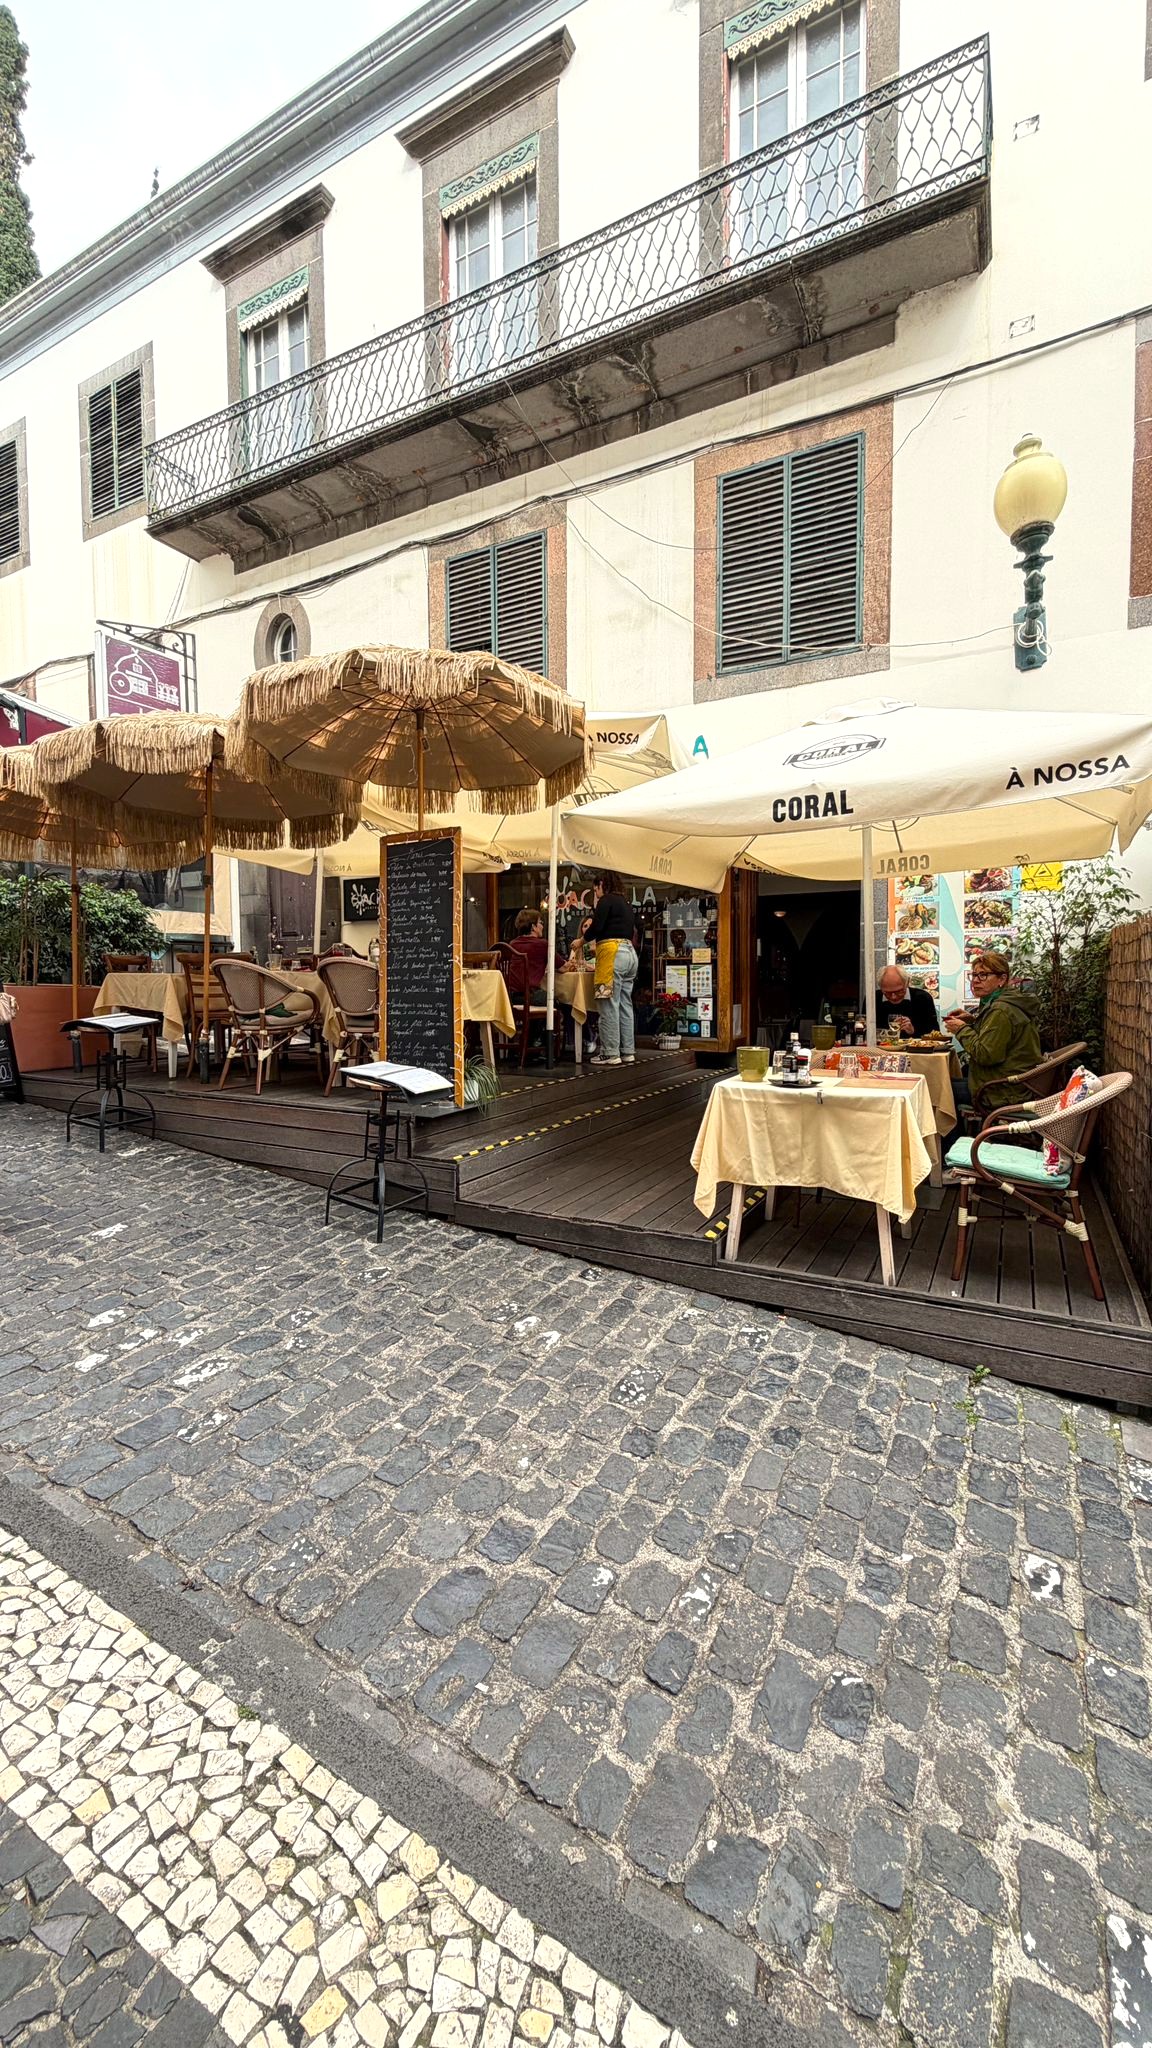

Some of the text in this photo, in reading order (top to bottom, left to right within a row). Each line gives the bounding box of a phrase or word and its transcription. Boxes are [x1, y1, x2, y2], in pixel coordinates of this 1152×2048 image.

[596, 732, 640, 745] NOSSA
[796, 741, 876, 762] CORAL
[1005, 754, 1131, 790] À NOSSA
[772, 790, 854, 823] CORAL
